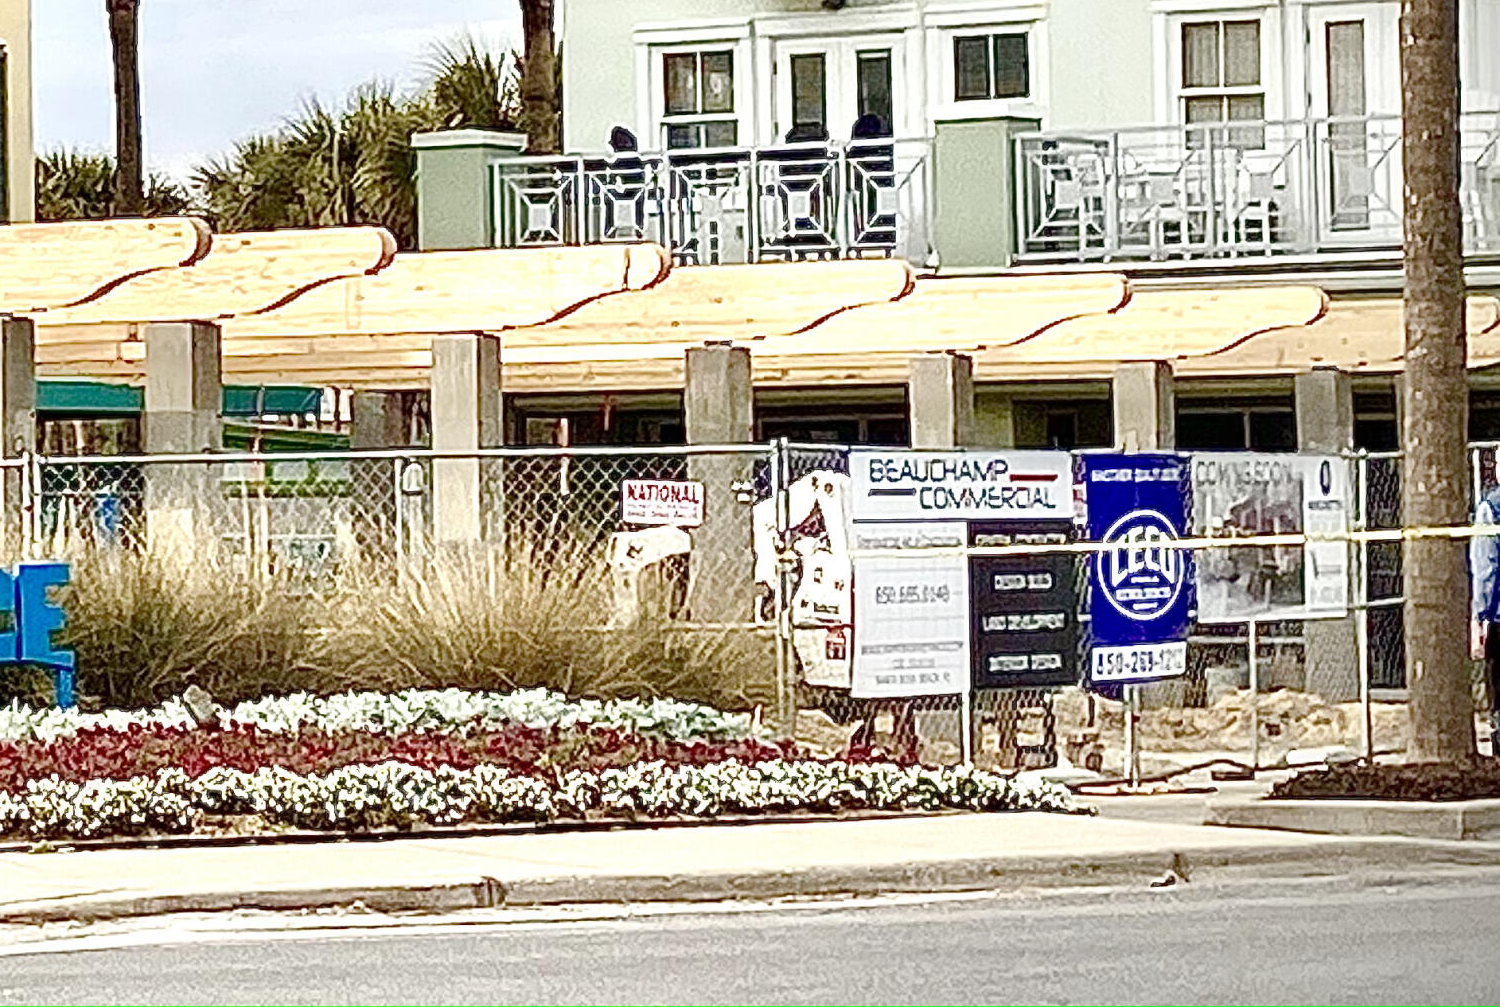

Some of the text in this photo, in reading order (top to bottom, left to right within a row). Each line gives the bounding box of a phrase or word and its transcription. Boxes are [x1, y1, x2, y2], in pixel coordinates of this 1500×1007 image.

[870, 459, 1009, 483] BEAUCHAMP
[627, 483, 699, 504] NATIONAL
[920, 486, 1057, 509] COMMERCIAL
[1111, 525, 1175, 586] CECO
